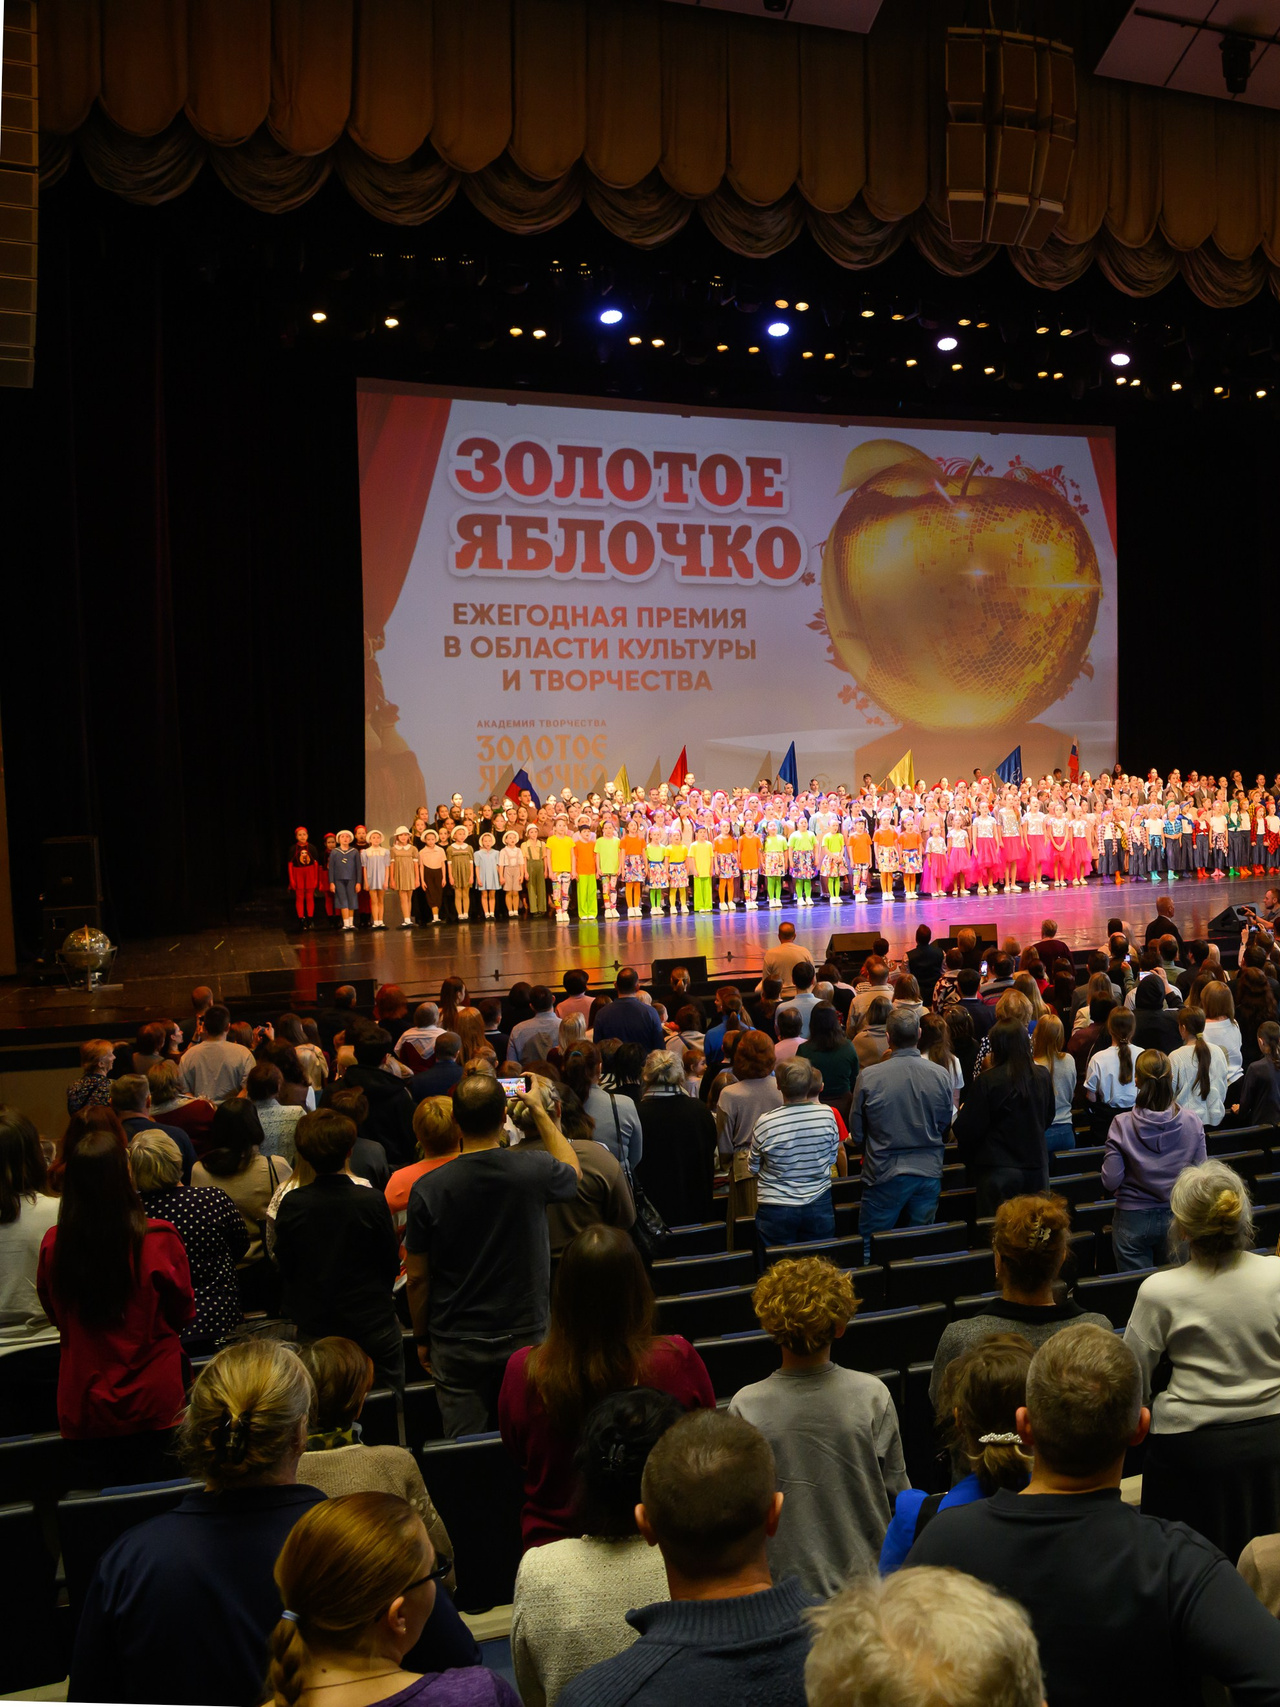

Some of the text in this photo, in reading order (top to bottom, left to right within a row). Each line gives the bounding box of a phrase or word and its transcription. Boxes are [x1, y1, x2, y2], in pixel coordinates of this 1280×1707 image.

[454, 437, 784, 509] ЗОЛОТОЕ
[454, 512, 802, 580] ЯБЛОЧКО
[452, 602, 747, 631] ЕЖЕГОДНАЯ ПРЕМИЯ
[443, 635, 757, 660] В ОБЛАСТИ КУЛЬТУРЫ
[502, 669, 714, 692] И ТВОРЧЕСТВА
[476, 718, 607, 729] АКАДЕМИЯ ТВОРЧЕСТВА
